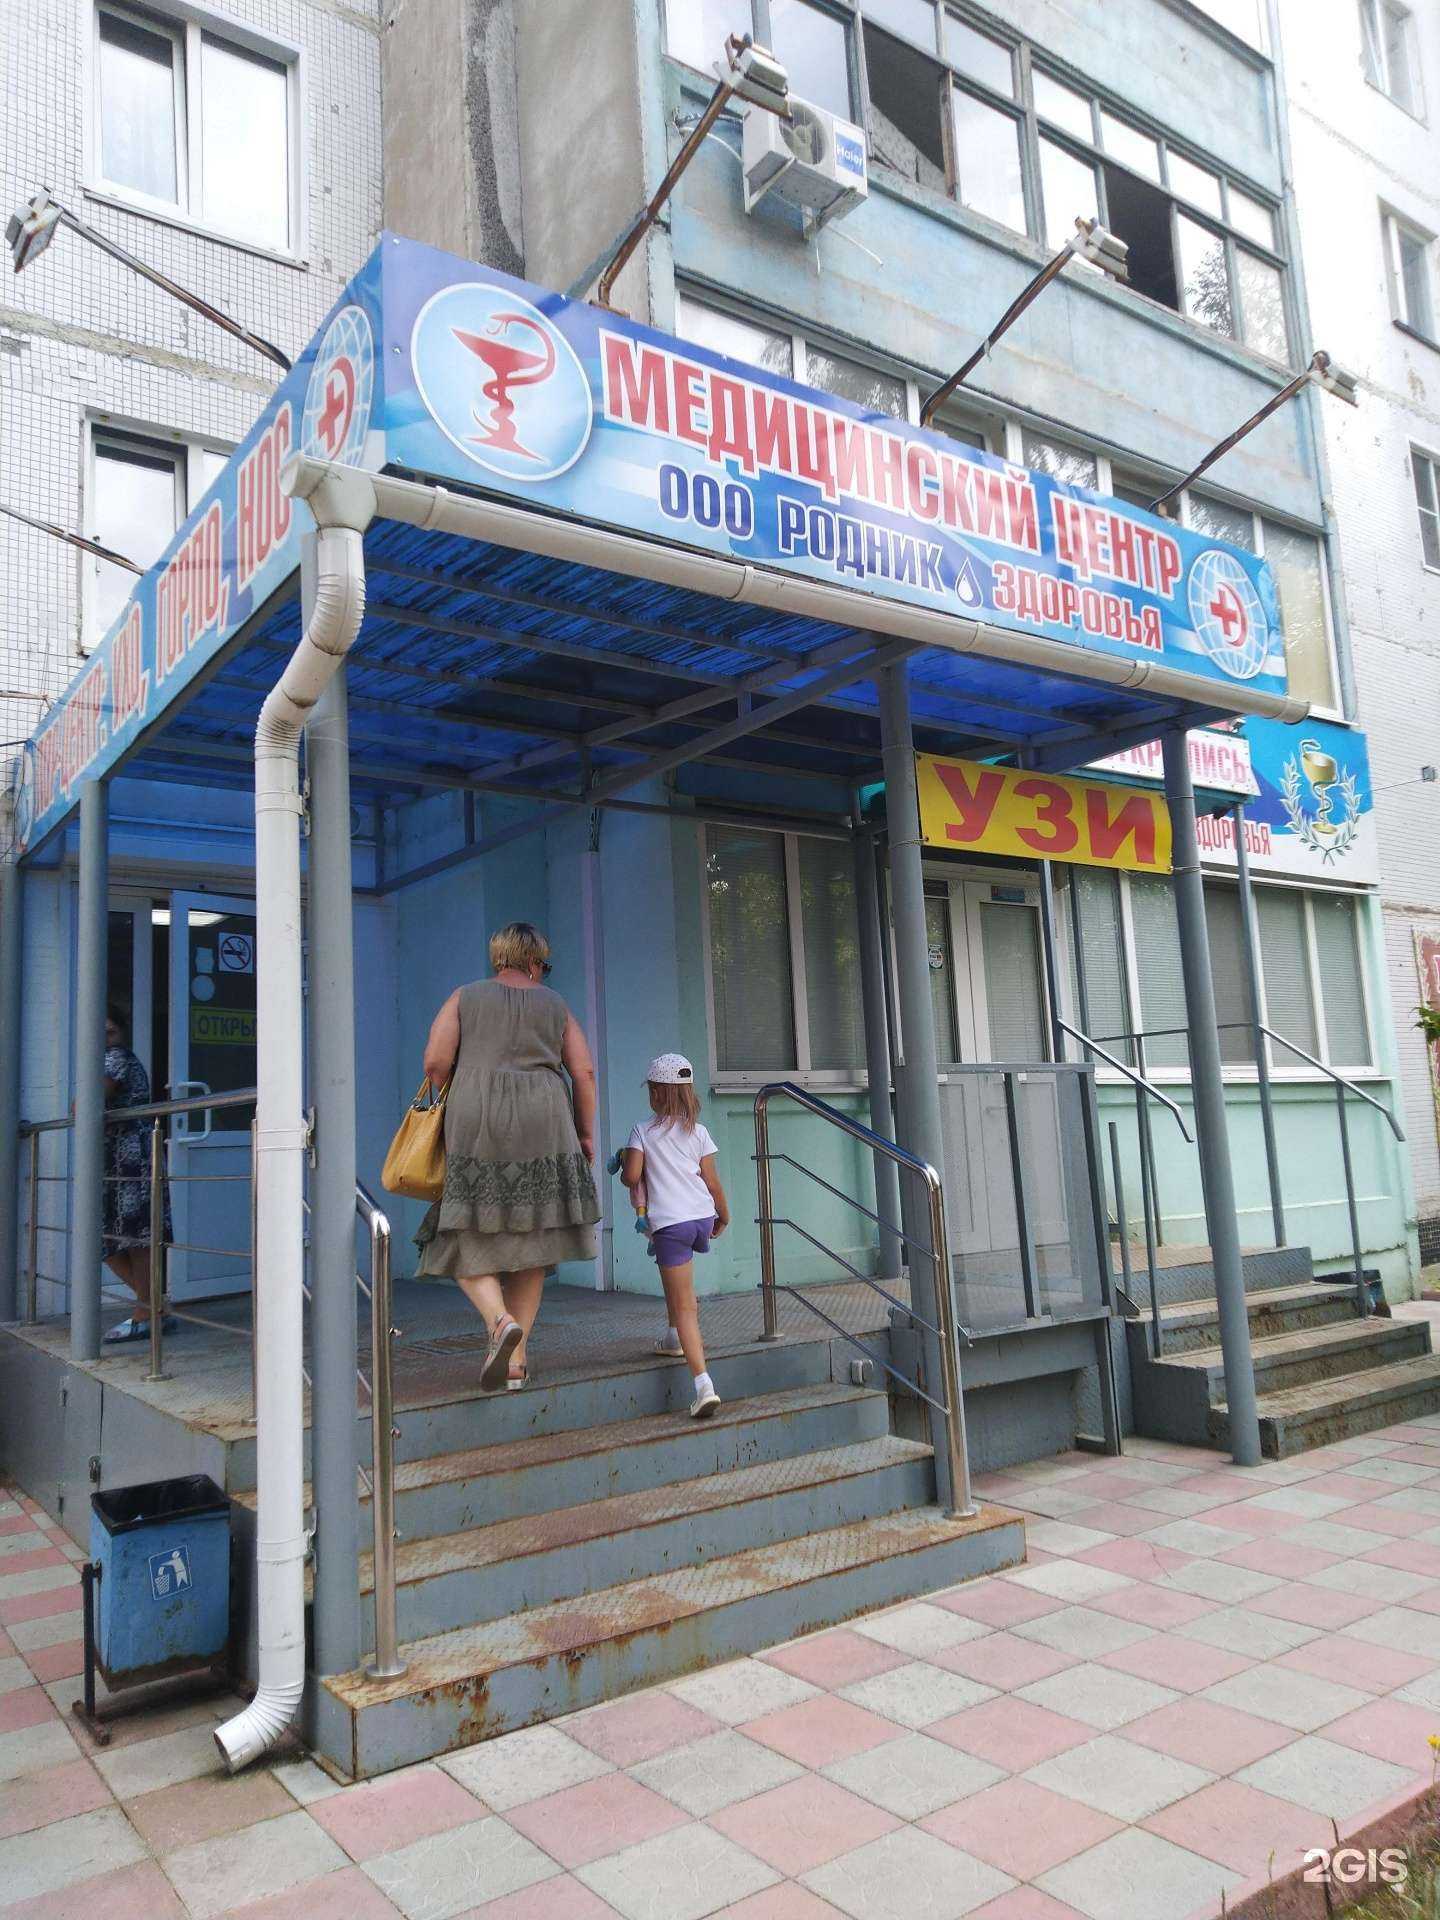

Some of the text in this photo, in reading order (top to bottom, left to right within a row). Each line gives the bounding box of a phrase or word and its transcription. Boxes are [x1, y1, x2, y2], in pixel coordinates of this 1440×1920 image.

[602, 335, 1183, 599] МЕДИЦИНСКИЙ ЦЕНТР
[113, 602, 149, 735] УХО,
[157, 501, 229, 688] ГОРЛО,
[238, 404, 292, 590] НОС
[660, 464, 1164, 651] ООО РОДНИК ЗДОРОВЬЯ
[932, 763, 1157, 864] УЗИ
[1188, 740, 1248, 784] ПИСЬ
[199, 1015, 257, 1037] ОТКРЫ
